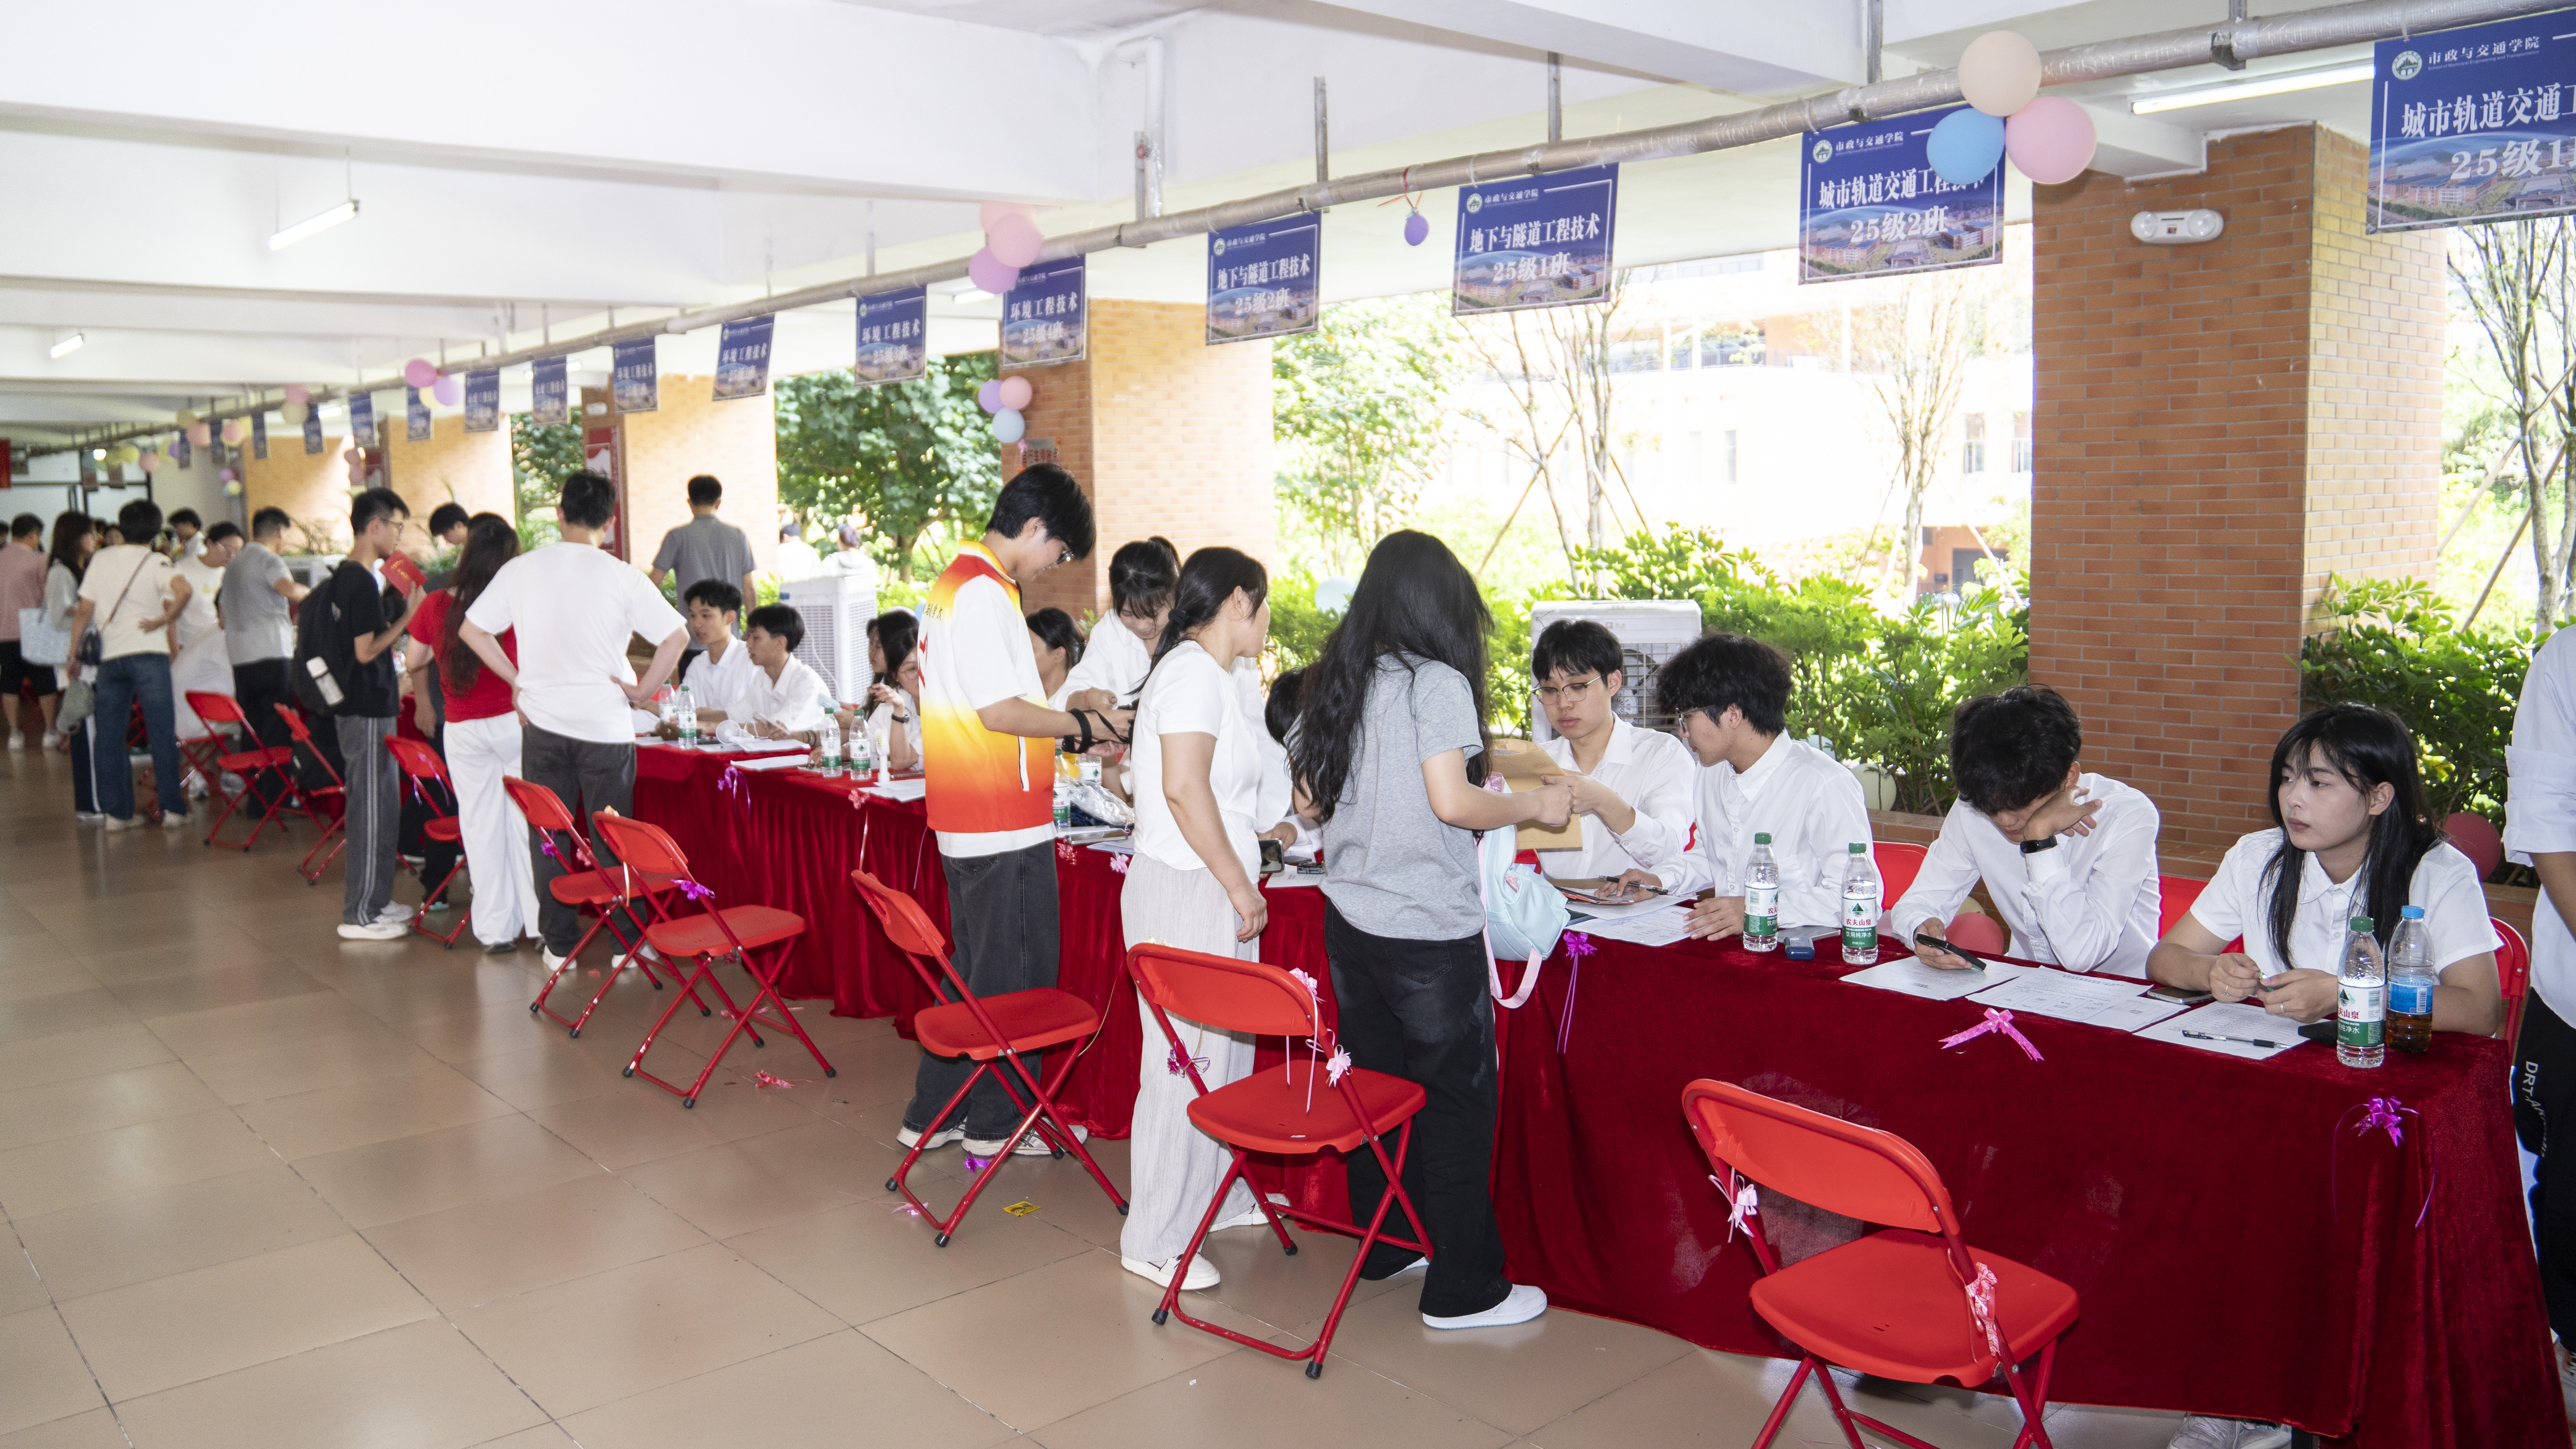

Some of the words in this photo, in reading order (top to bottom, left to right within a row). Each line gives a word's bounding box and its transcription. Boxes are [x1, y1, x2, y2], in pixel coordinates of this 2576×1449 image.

[2428, 36, 2540, 65] 市政与交通学院
[2469, 57, 2496, 65] Engineering
[2507, 50, 2539, 59] Transportation
[1835, 131, 1904, 151] 市政与交通学院
[2450, 136, 2576, 181] 25级1
[1485, 188, 1538, 204] 市政与交通学院
[1818, 166, 1984, 209] 城市轨道交通工
[1469, 213, 1600, 253] 地下与隧道工程技术
[1850, 205, 1949, 243] 25级2班
[1217, 253, 1310, 289] 地下与隧道工程技术
[1493, 251, 1571, 282] 25级1班
[1010, 291, 1078, 321] 环境工程技术
[1235, 287, 1290, 315] 25级2班
[1022, 320, 1064, 343] 25级4班
